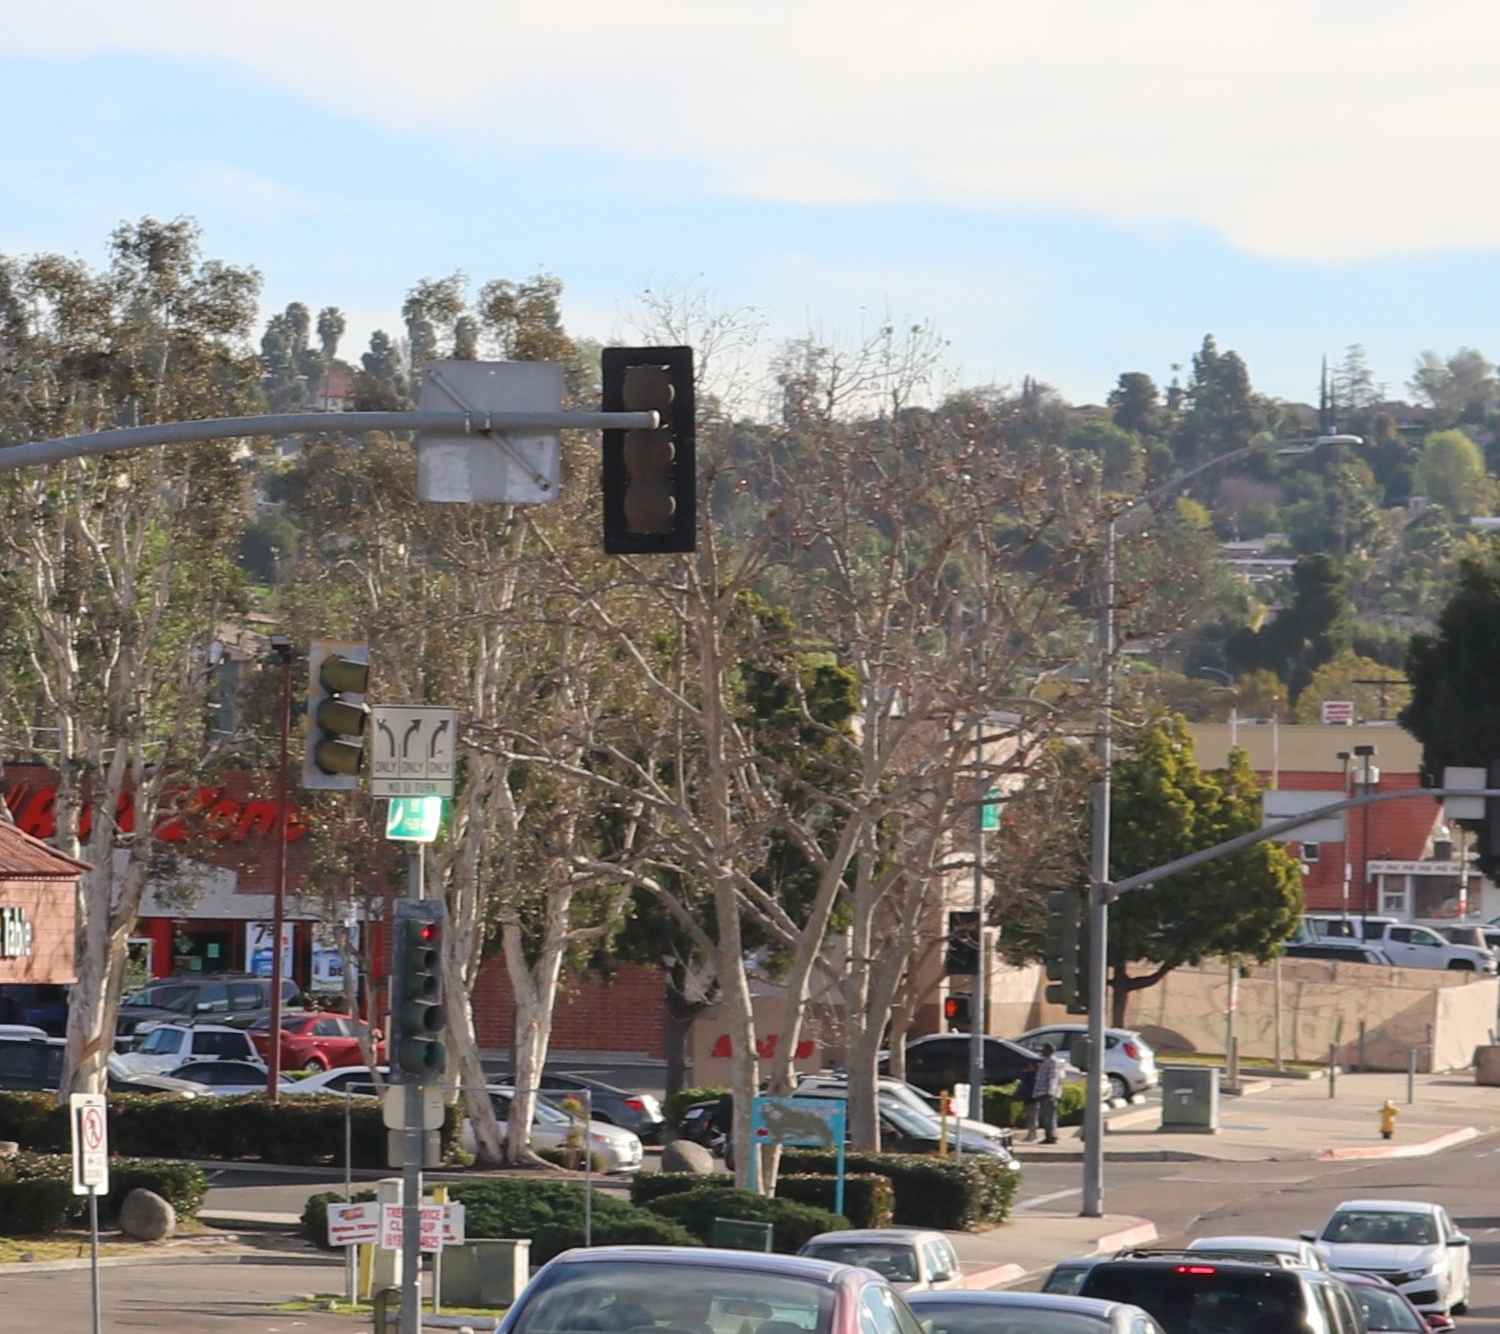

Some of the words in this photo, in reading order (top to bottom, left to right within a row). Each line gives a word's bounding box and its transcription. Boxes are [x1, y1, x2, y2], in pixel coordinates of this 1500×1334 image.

[389, 782, 400, 793] NO
[404, 782, 411, 793] U
[3, 907, 32, 957] Table
